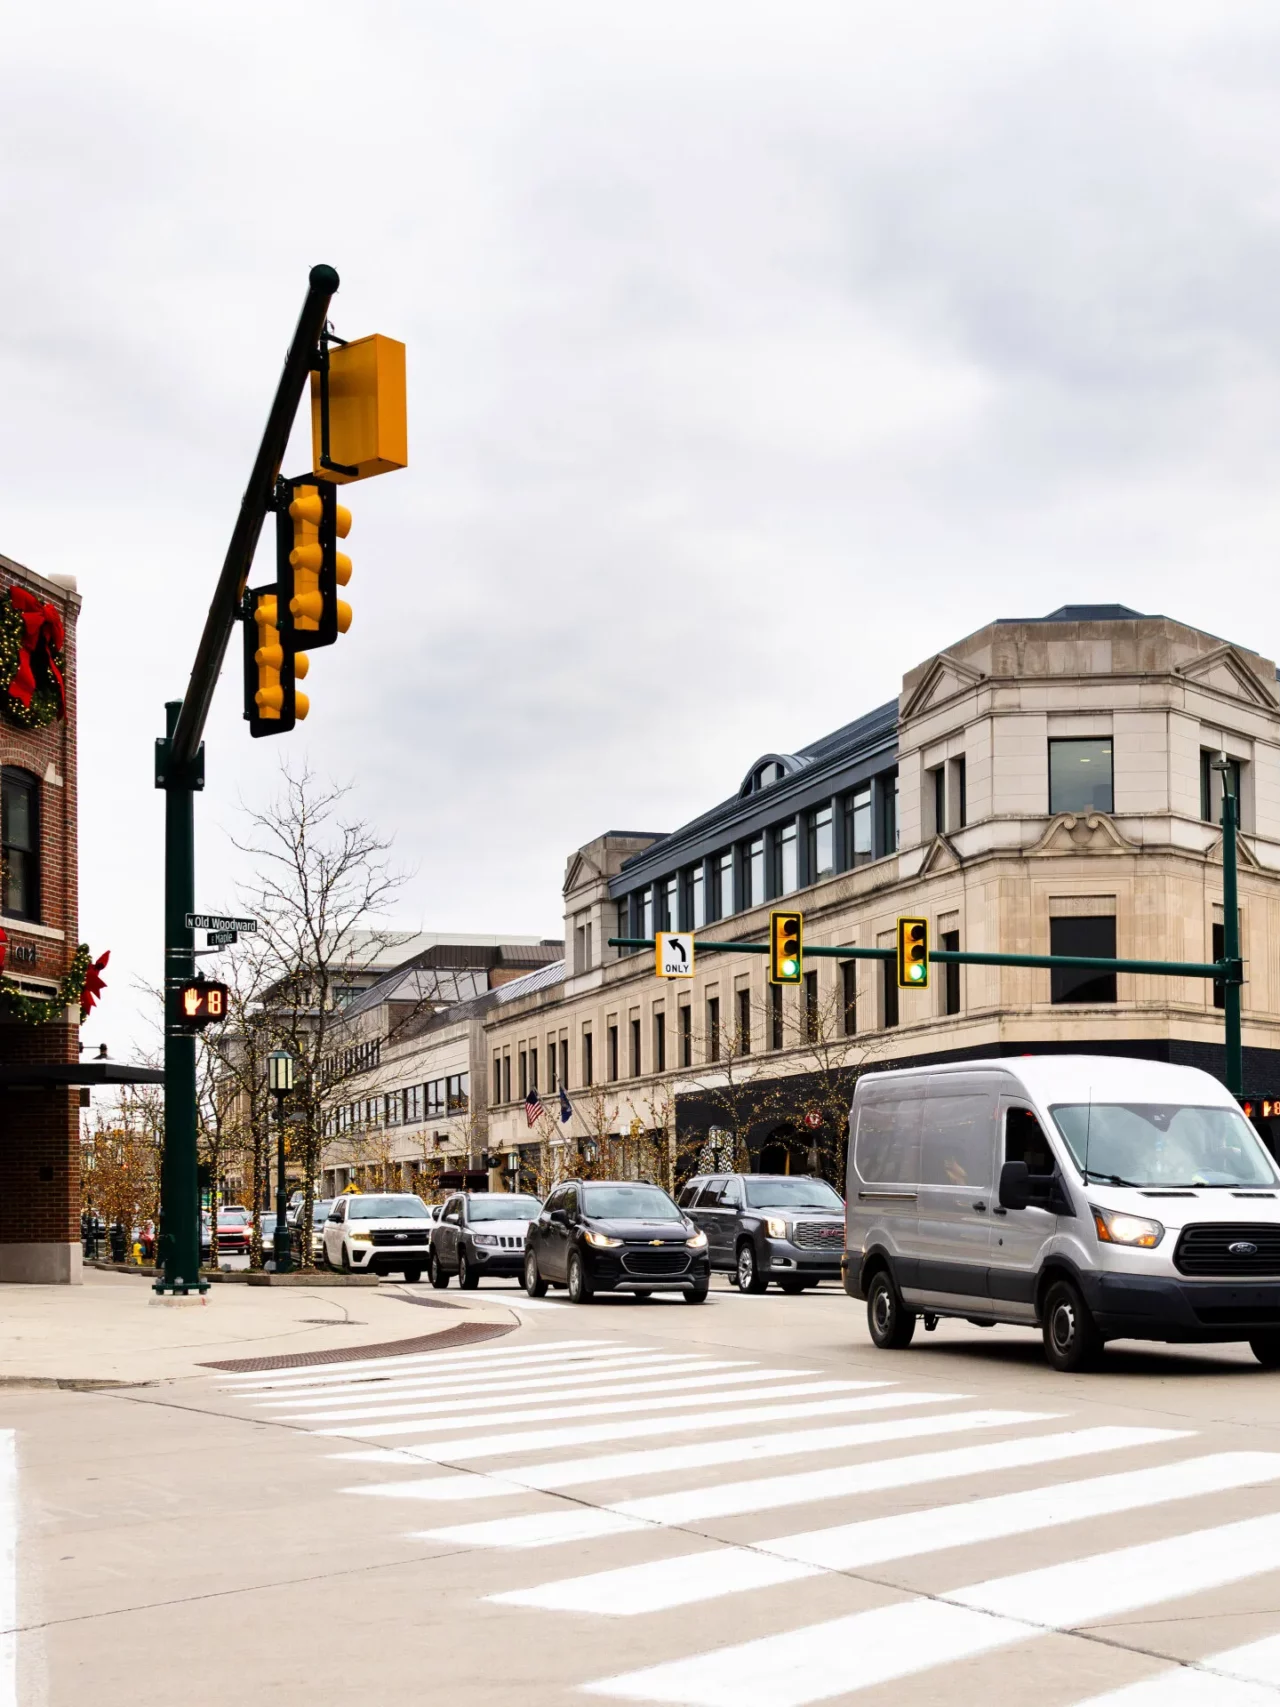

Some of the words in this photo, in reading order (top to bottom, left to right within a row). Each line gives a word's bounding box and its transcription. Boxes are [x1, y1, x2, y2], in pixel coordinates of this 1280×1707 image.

[187, 918, 193, 927] N
[195, 916, 209, 928] Old
[211, 917, 256, 932] Woodward
[215, 932, 233, 944] Maple
[665, 964, 690, 973] ONLY
[207, 990, 222, 1015] 18
